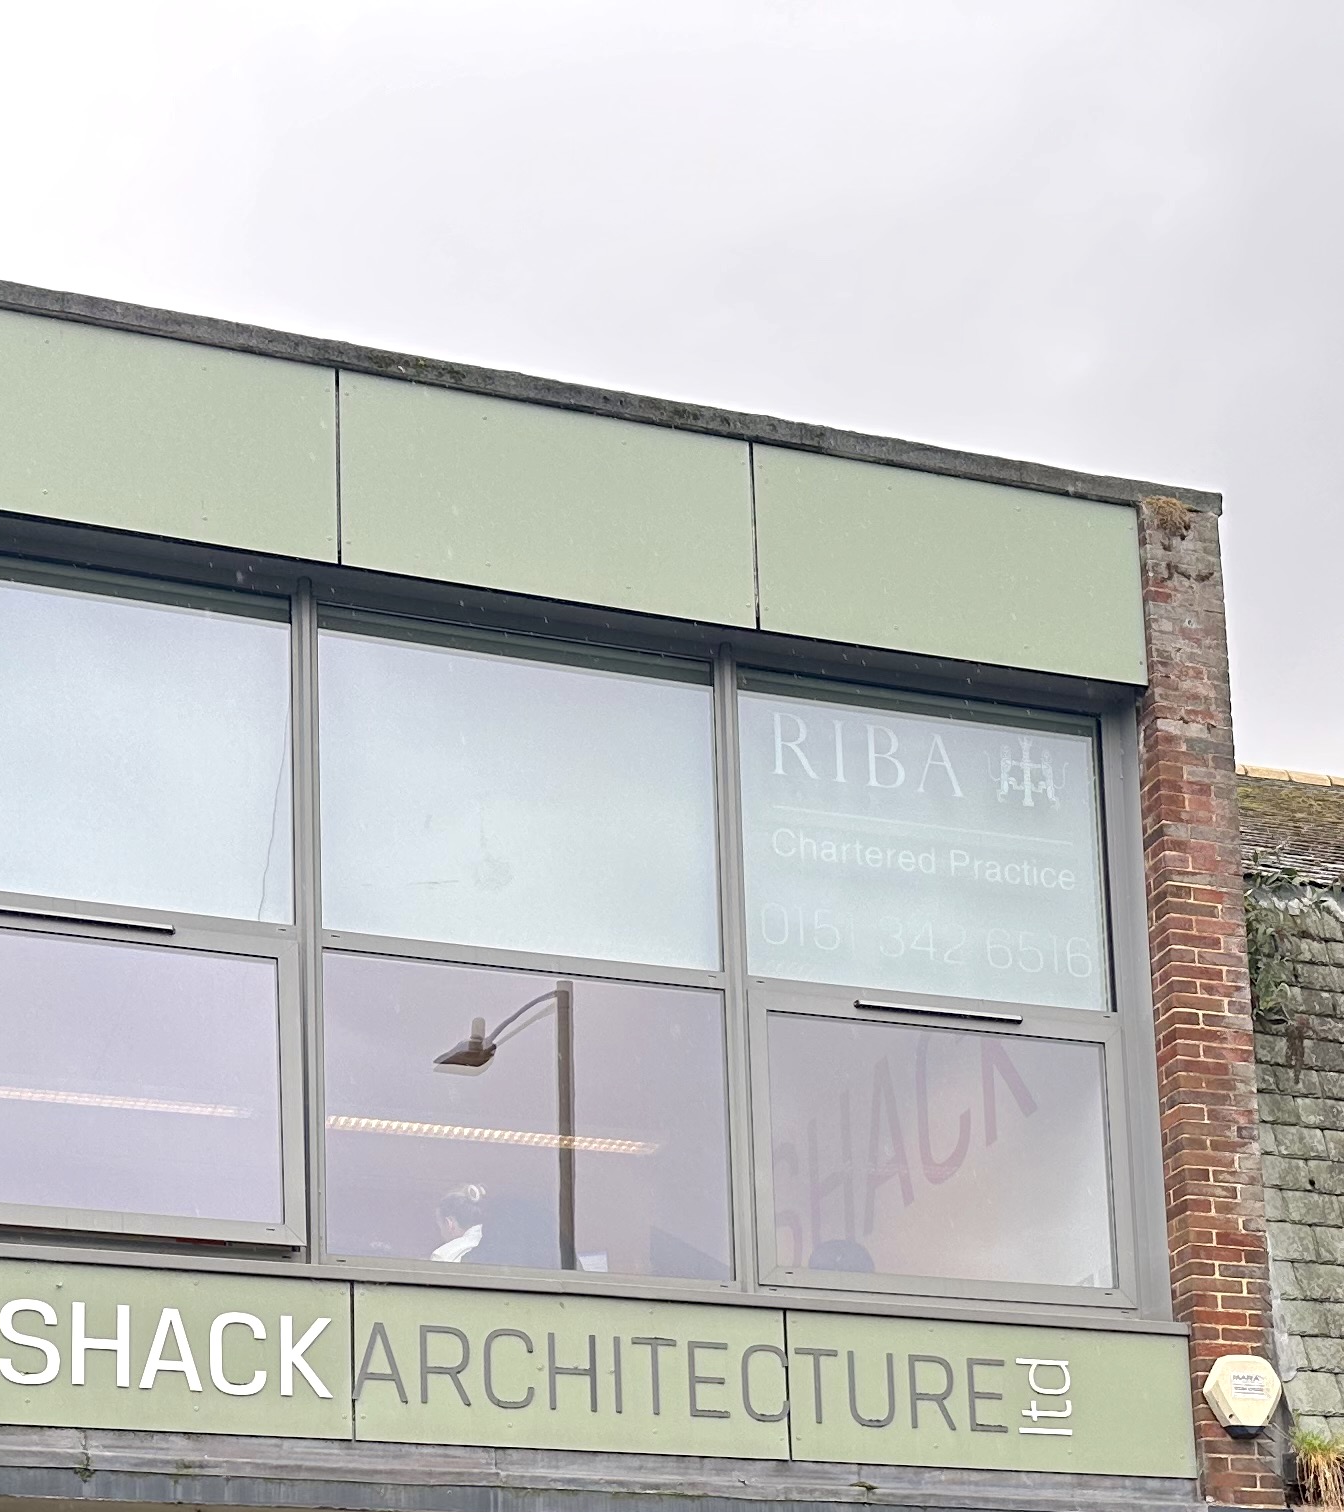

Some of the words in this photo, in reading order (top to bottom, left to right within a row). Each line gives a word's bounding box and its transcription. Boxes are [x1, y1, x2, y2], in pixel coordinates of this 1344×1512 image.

[771, 711, 964, 798] RIBA
[771, 827, 936, 875] Chartered
[949, 849, 1076, 891] Practice
[986, 926, 1094, 979] 6516
[353, 1321, 1009, 1434] ARCHITECTURE
[1015, 1357, 1073, 1437] ltd
